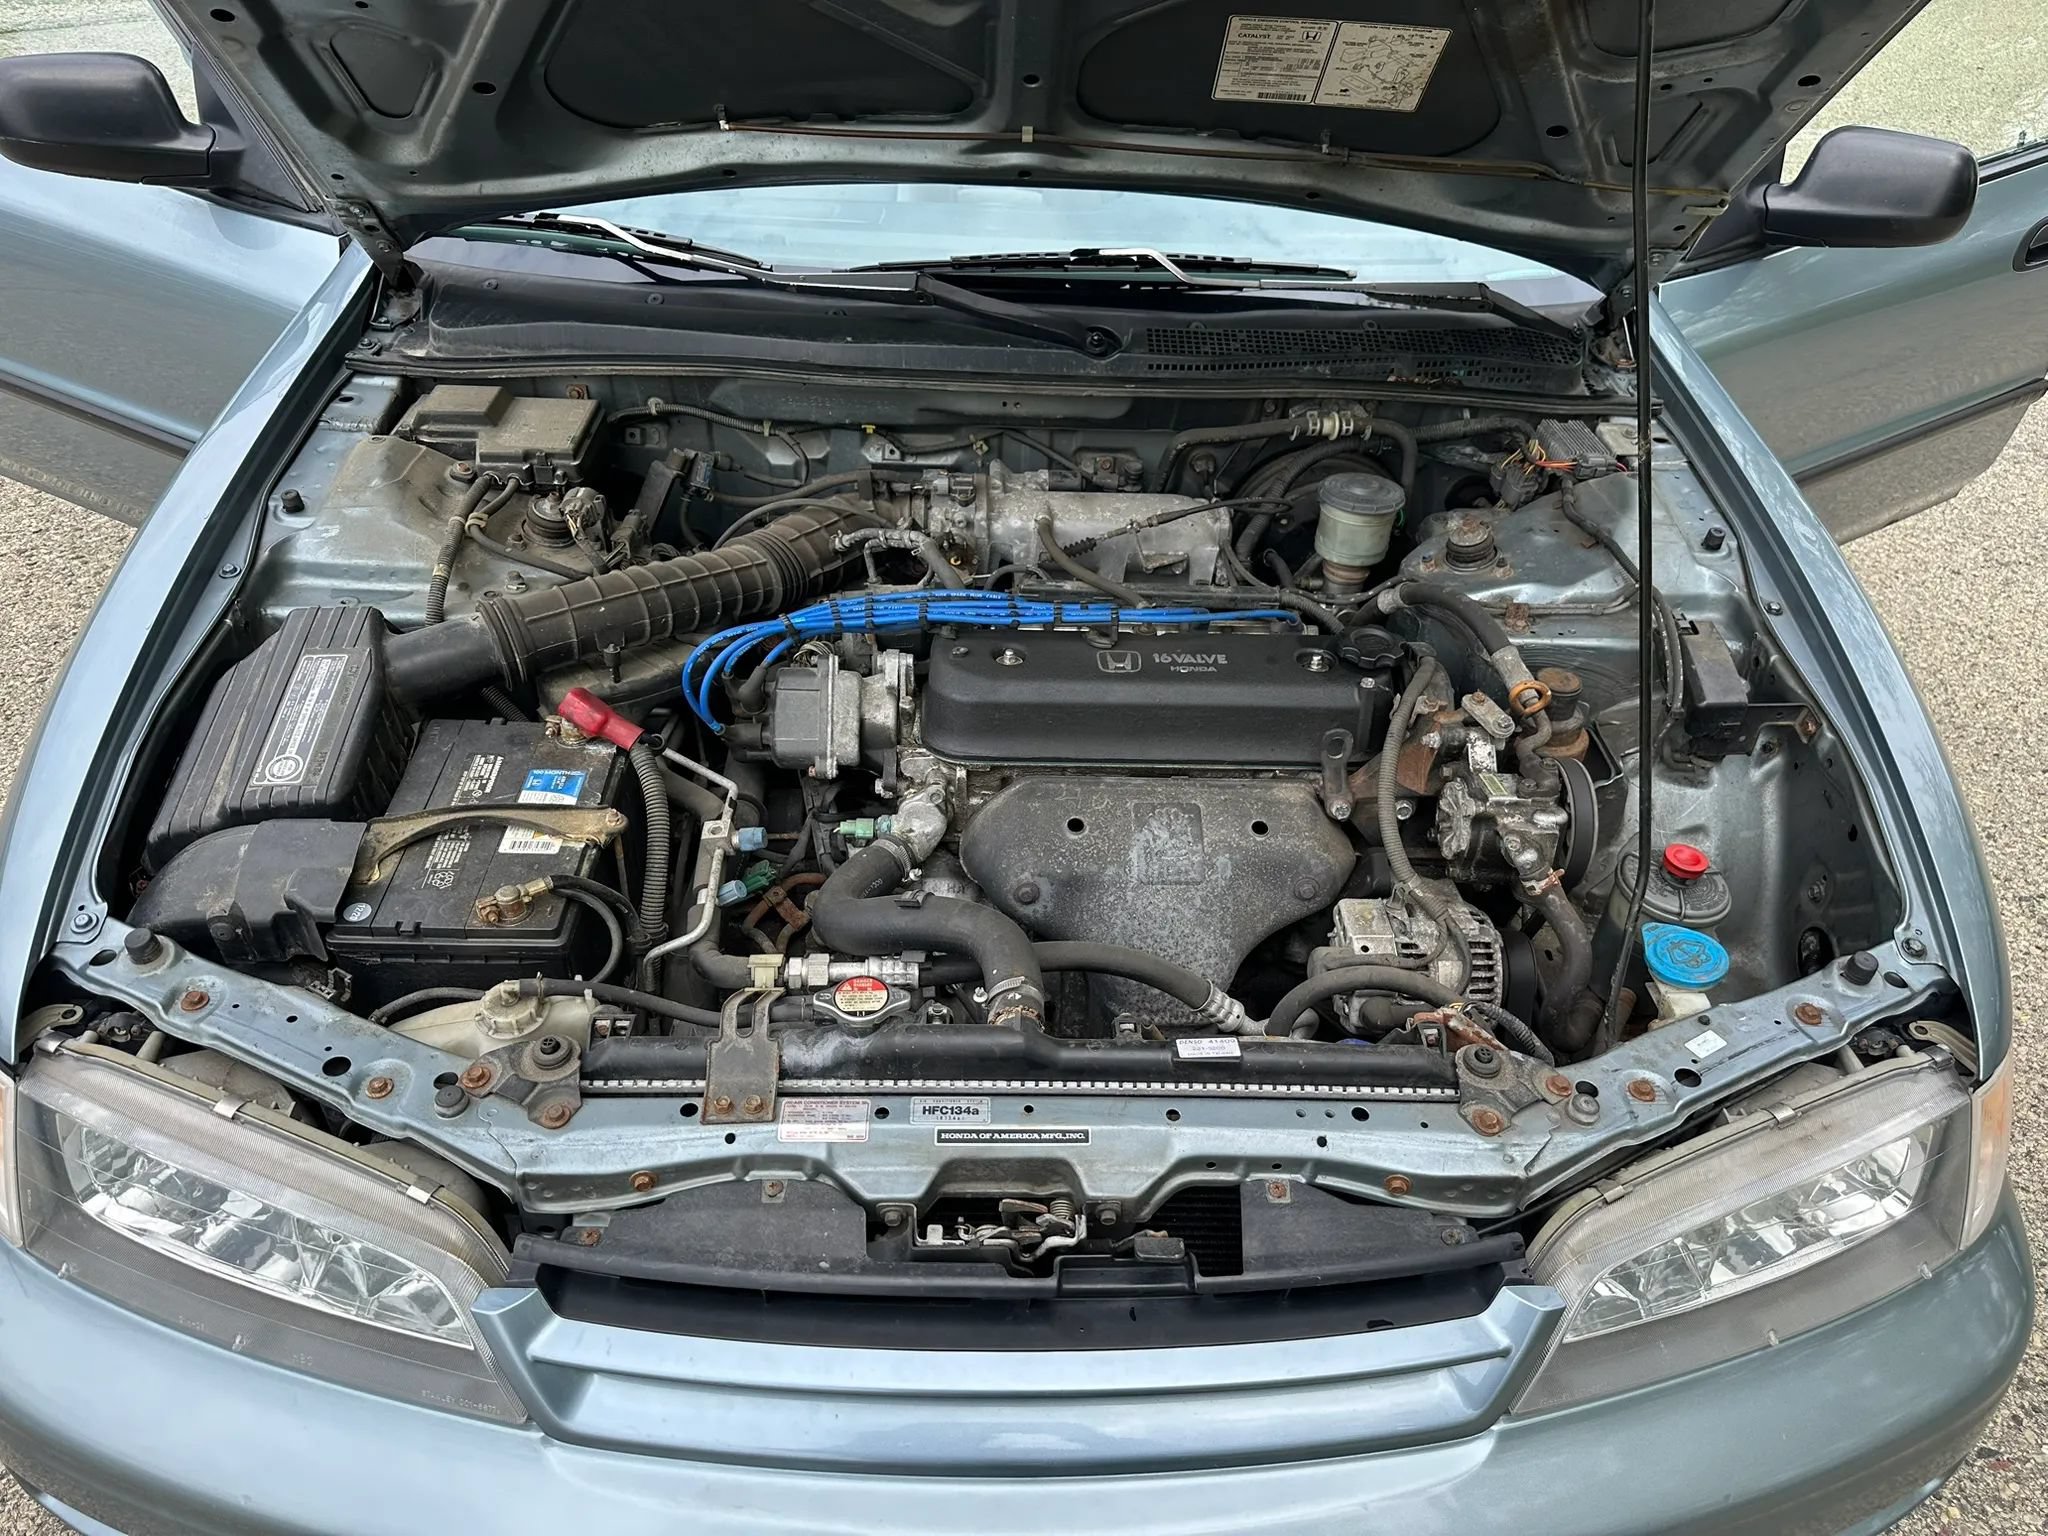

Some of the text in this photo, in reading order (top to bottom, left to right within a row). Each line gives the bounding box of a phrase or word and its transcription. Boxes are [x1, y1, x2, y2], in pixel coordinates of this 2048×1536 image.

[1170, 665, 1218, 673] HONDA
[922, 1105, 980, 1116] HFC134a
[940, 1132, 978, 1140] HONDA
[979, 1132, 993, 1140] OF
[994, 1132, 1040, 1140] AMERICA
